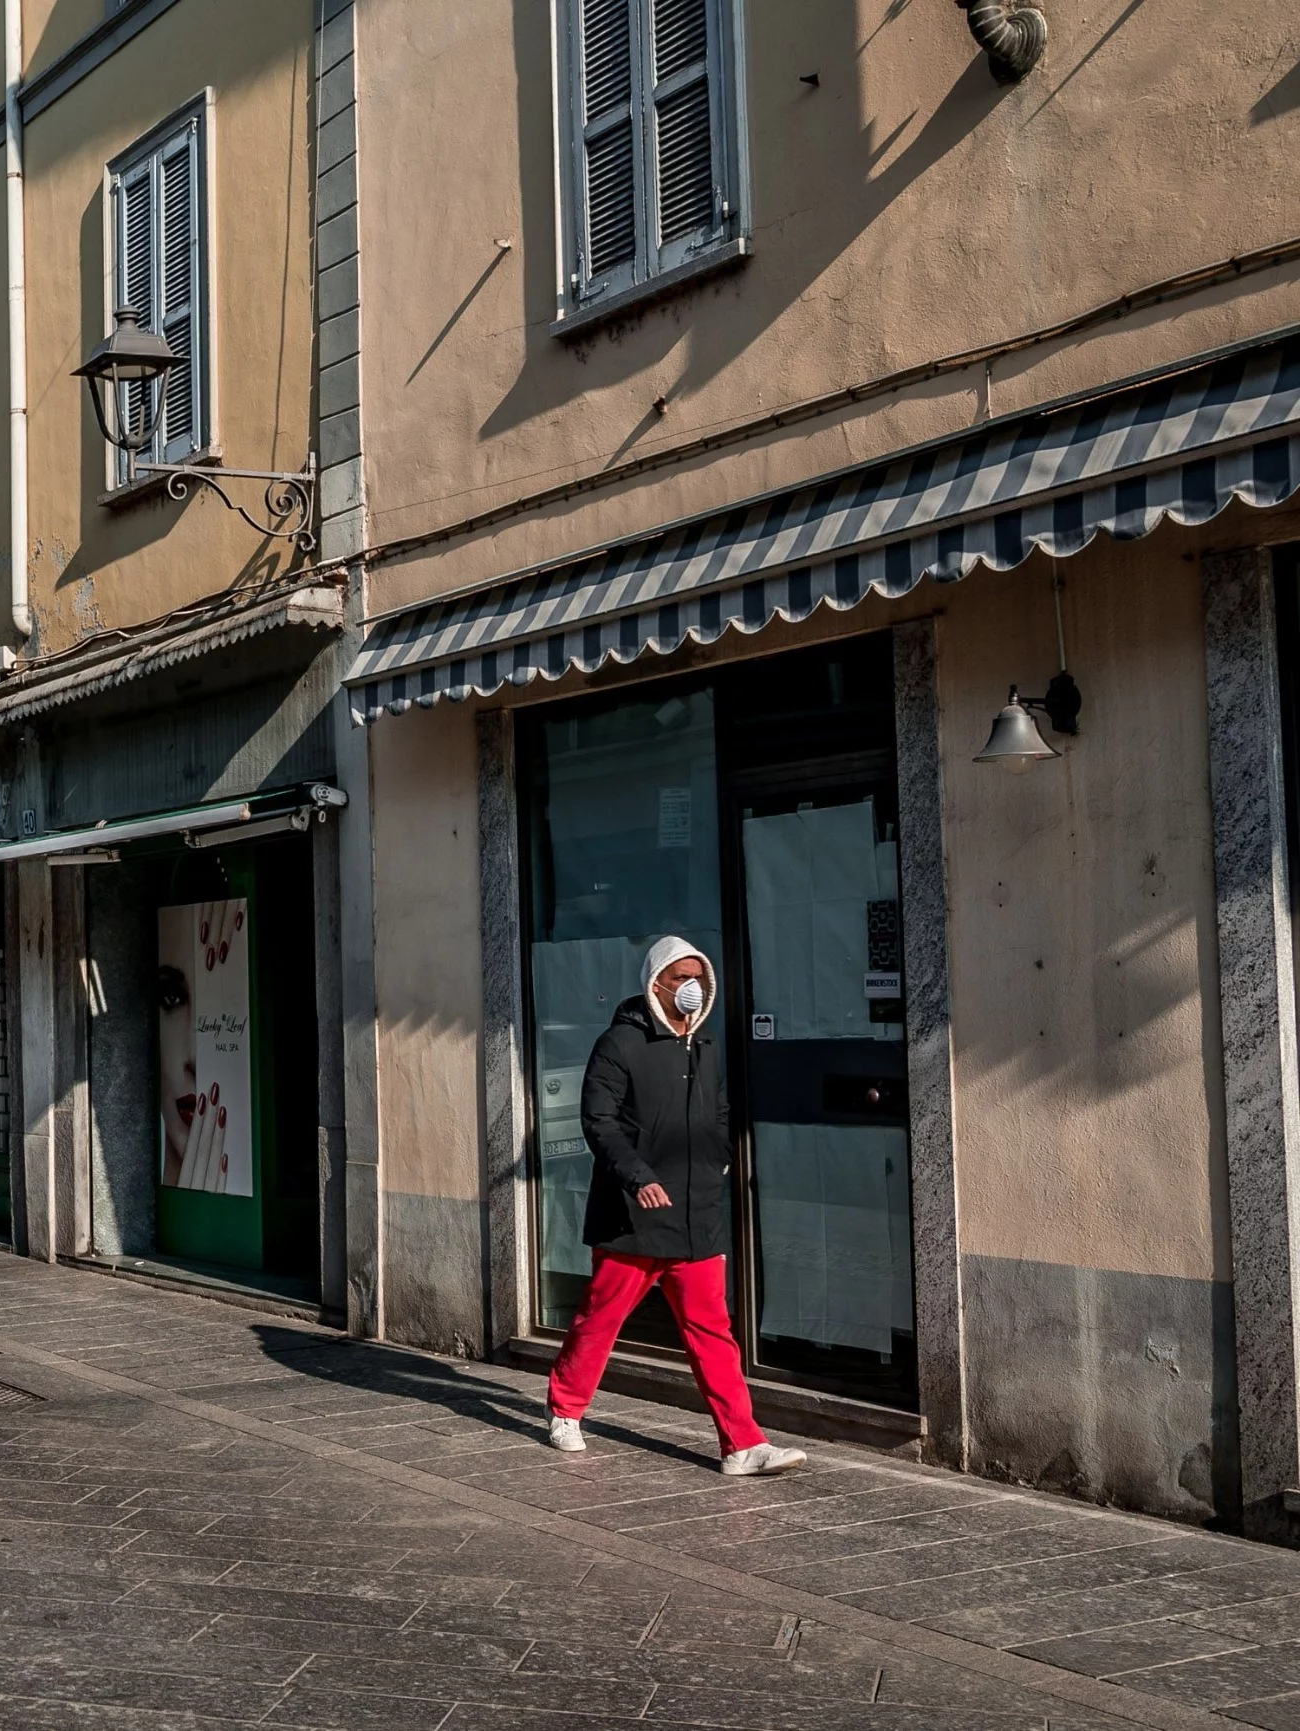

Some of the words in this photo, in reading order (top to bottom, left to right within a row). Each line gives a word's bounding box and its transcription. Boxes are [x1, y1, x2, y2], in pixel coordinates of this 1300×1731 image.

[25, 811, 34, 832] 40
[198, 1015, 221, 1039] Lucky
[225, 1014, 248, 1038] Leaf
